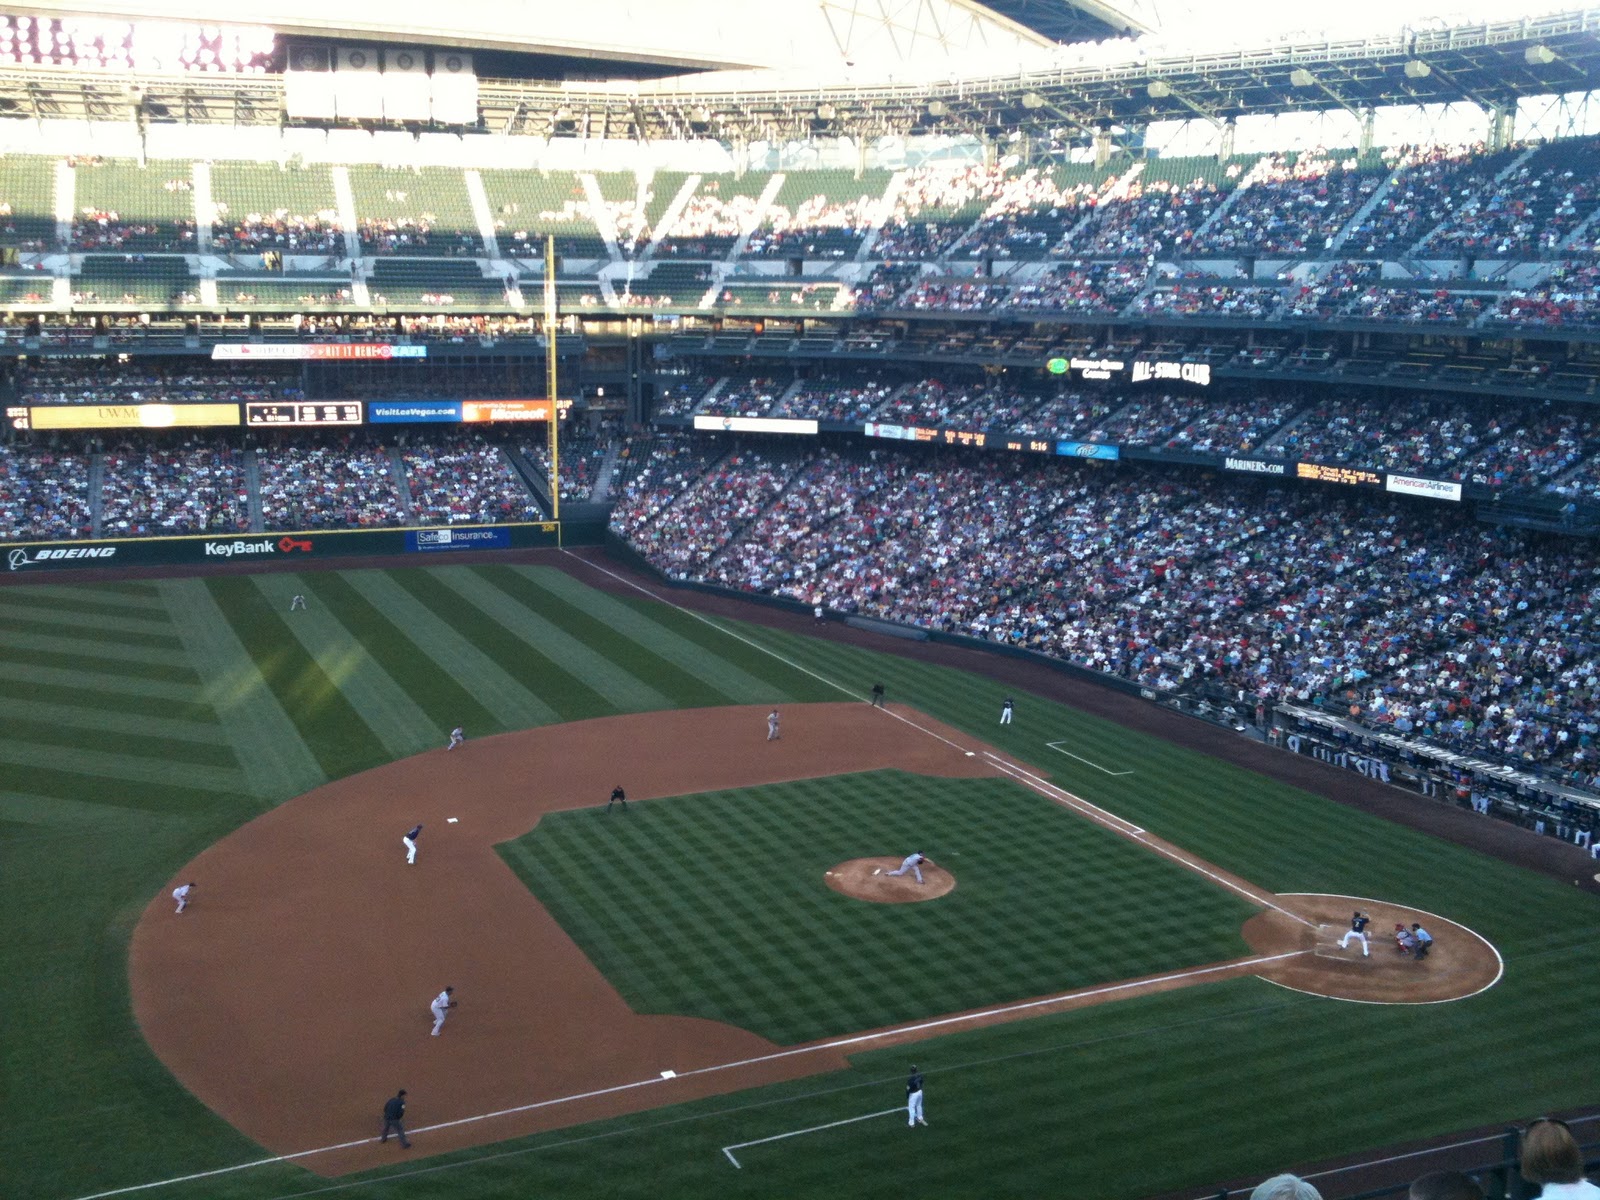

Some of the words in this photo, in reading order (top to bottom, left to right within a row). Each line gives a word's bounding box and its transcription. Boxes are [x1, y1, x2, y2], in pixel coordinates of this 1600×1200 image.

[419, 531, 449, 542] Safeco
[452, 530, 493, 541] Insurance
[35, 547, 116, 560] BOEING
[205, 540, 274, 557] KeyBank
